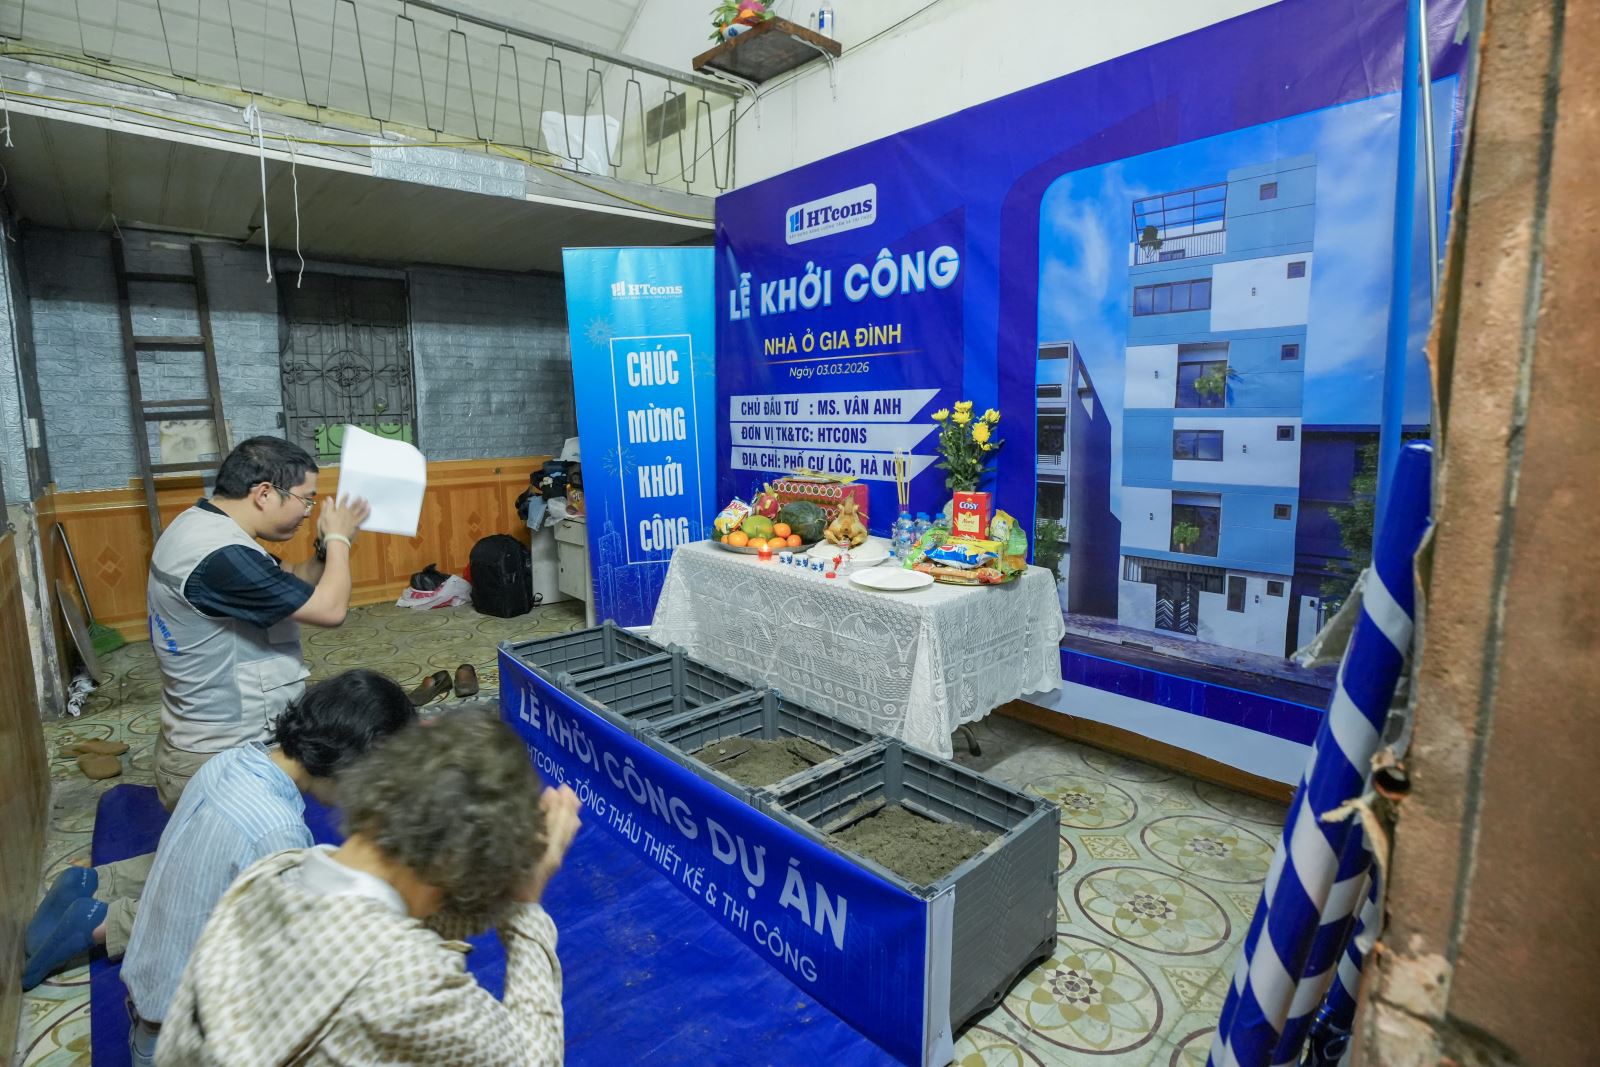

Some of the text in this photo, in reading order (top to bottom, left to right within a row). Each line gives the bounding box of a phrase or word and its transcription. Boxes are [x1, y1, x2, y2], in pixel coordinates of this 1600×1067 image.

[807, 198, 873, 228] HTcons
[628, 283, 683, 296] HTcons
[730, 246, 960, 321] LỄ KHỞI CÔNG
[764, 323, 902, 356] NHÀ Ở GIA ĐÌNH
[626, 344, 680, 388] CHÚC
[789, 362, 870, 380] Ngày 03.03.2026
[741, 397, 760, 416] CHỦ
[764, 396, 781, 416] ĐẦU
[784, 398, 800, 416] TƯ
[818, 400, 840, 415] MS.
[844, 396, 869, 415] VÂN
[874, 398, 902, 415] ANH
[628, 403, 686, 444] MỪNG
[741, 424, 868, 444] ĐƠN VỊ TK&TC: HTCONS
[638, 456, 684, 498] KHỞI
[742, 452, 758, 470] ĐỊA
[784, 450, 804, 470] PHỐ
[860, 456, 878, 476] HÀ
[959, 500, 979, 510] COSY
[640, 514, 690, 552] CÔNG
[520, 681, 848, 951] LỄ KHỞI CÔNG DỰ ÁN
[526, 743, 564, 784] HTCONS
[575, 778, 606, 816] TỔNG
[608, 804, 642, 844] THẦU
[644, 830, 681, 876] THIẾT
[682, 863, 705, 895] KẾ
[706, 882, 717, 908] &
[722, 892, 749, 932] THI
[753, 920, 818, 982] CÔNG
